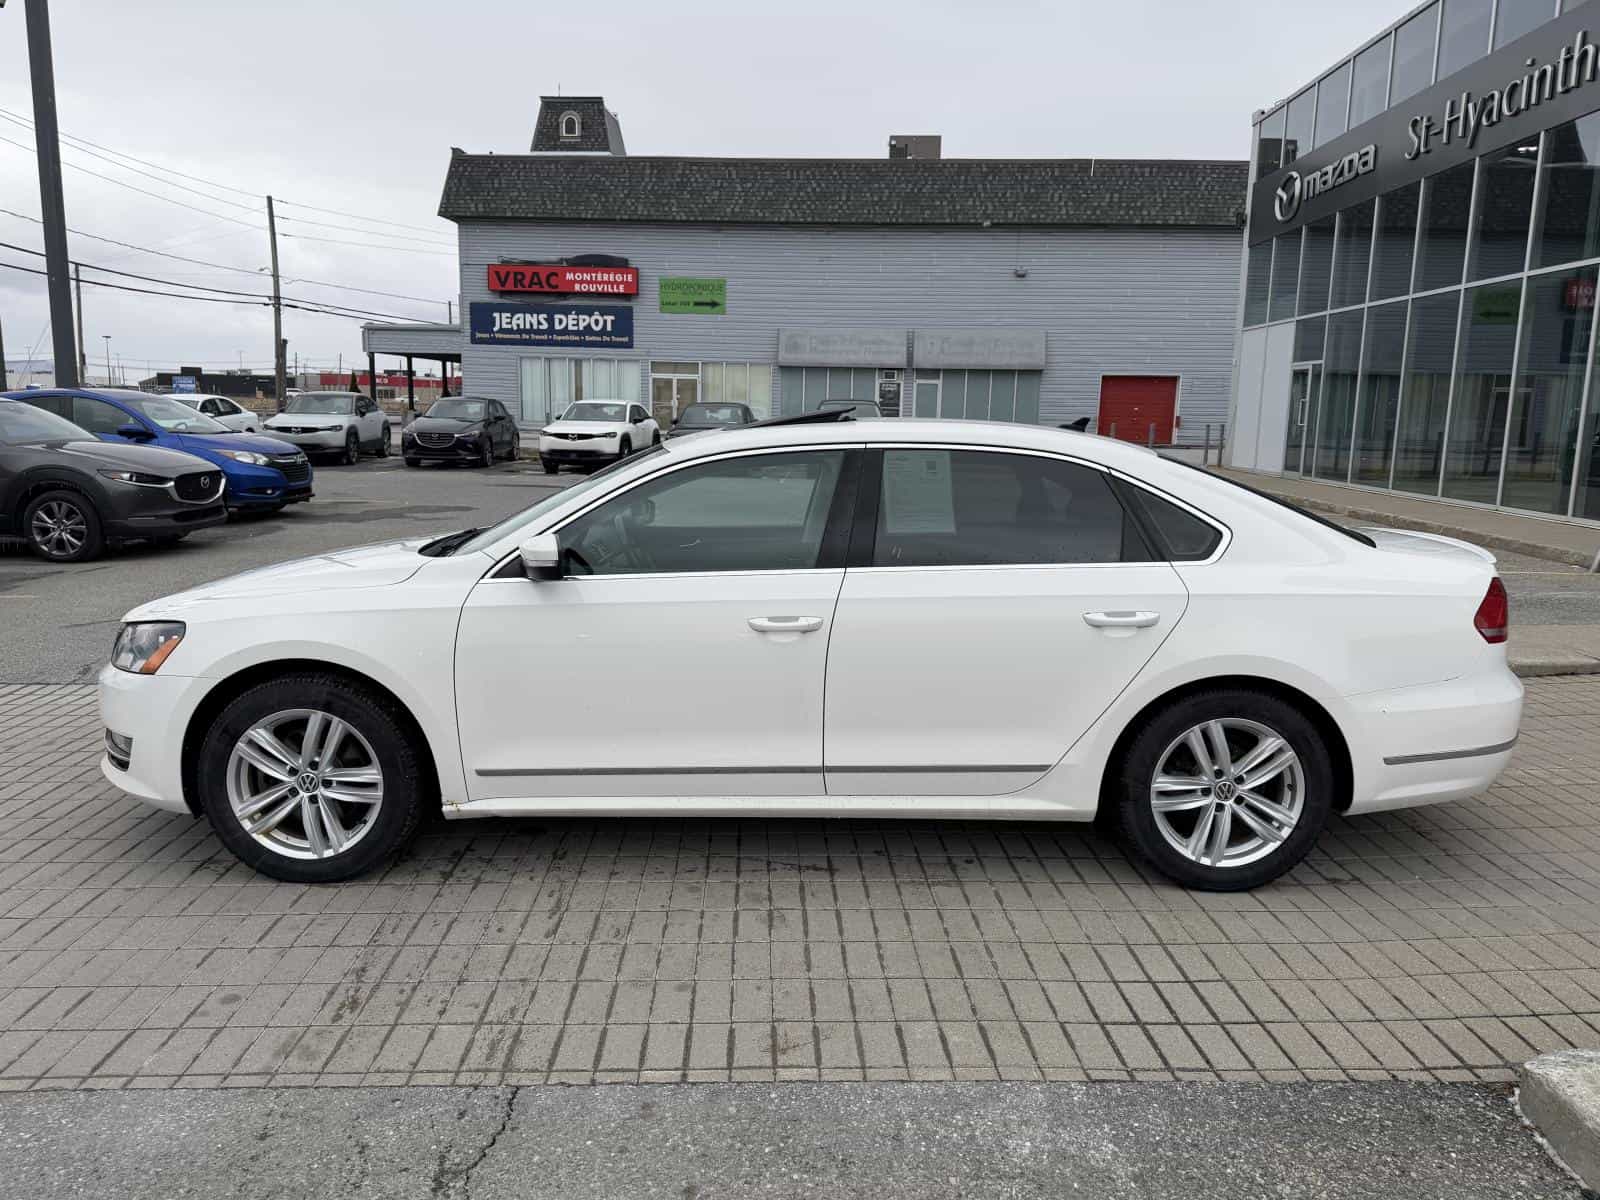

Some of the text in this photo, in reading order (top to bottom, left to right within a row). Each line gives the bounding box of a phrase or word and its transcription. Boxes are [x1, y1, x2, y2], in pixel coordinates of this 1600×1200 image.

[1404, 29, 1600, 160] St-Hyacinth
[494, 271, 559, 289] VRAC
[565, 271, 633, 282] MONTÉRÉGIE
[574, 281, 625, 293] ROUVILLE
[492, 311, 615, 331] JEANS DÉPÔT
